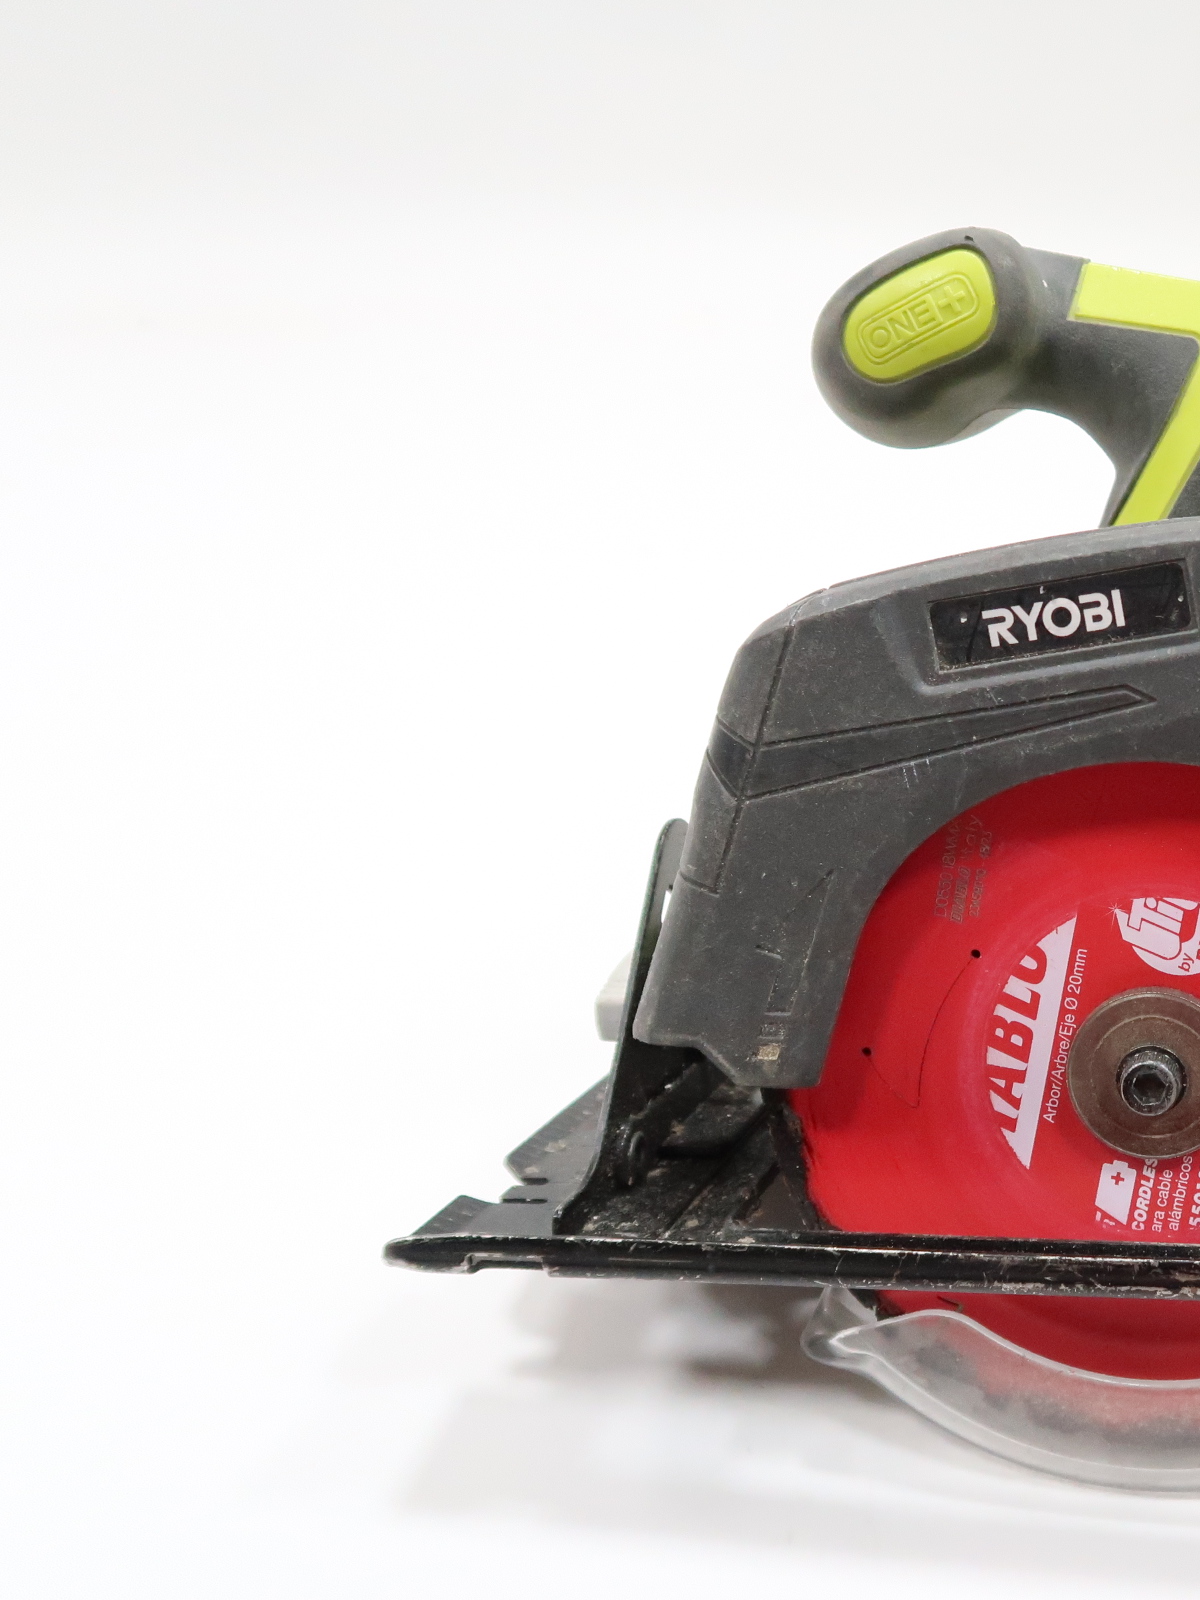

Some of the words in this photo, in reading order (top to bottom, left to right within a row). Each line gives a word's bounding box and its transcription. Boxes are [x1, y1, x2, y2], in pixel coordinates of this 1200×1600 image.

[981, 588, 1126, 648] RYOBI
[1178, 952, 1195, 972] by
[1043, 1016, 1077, 1123] Arbor/Arbre/Eje
[1067, 948, 1088, 995] 20mm
[1157, 1169, 1173, 1208] cable
